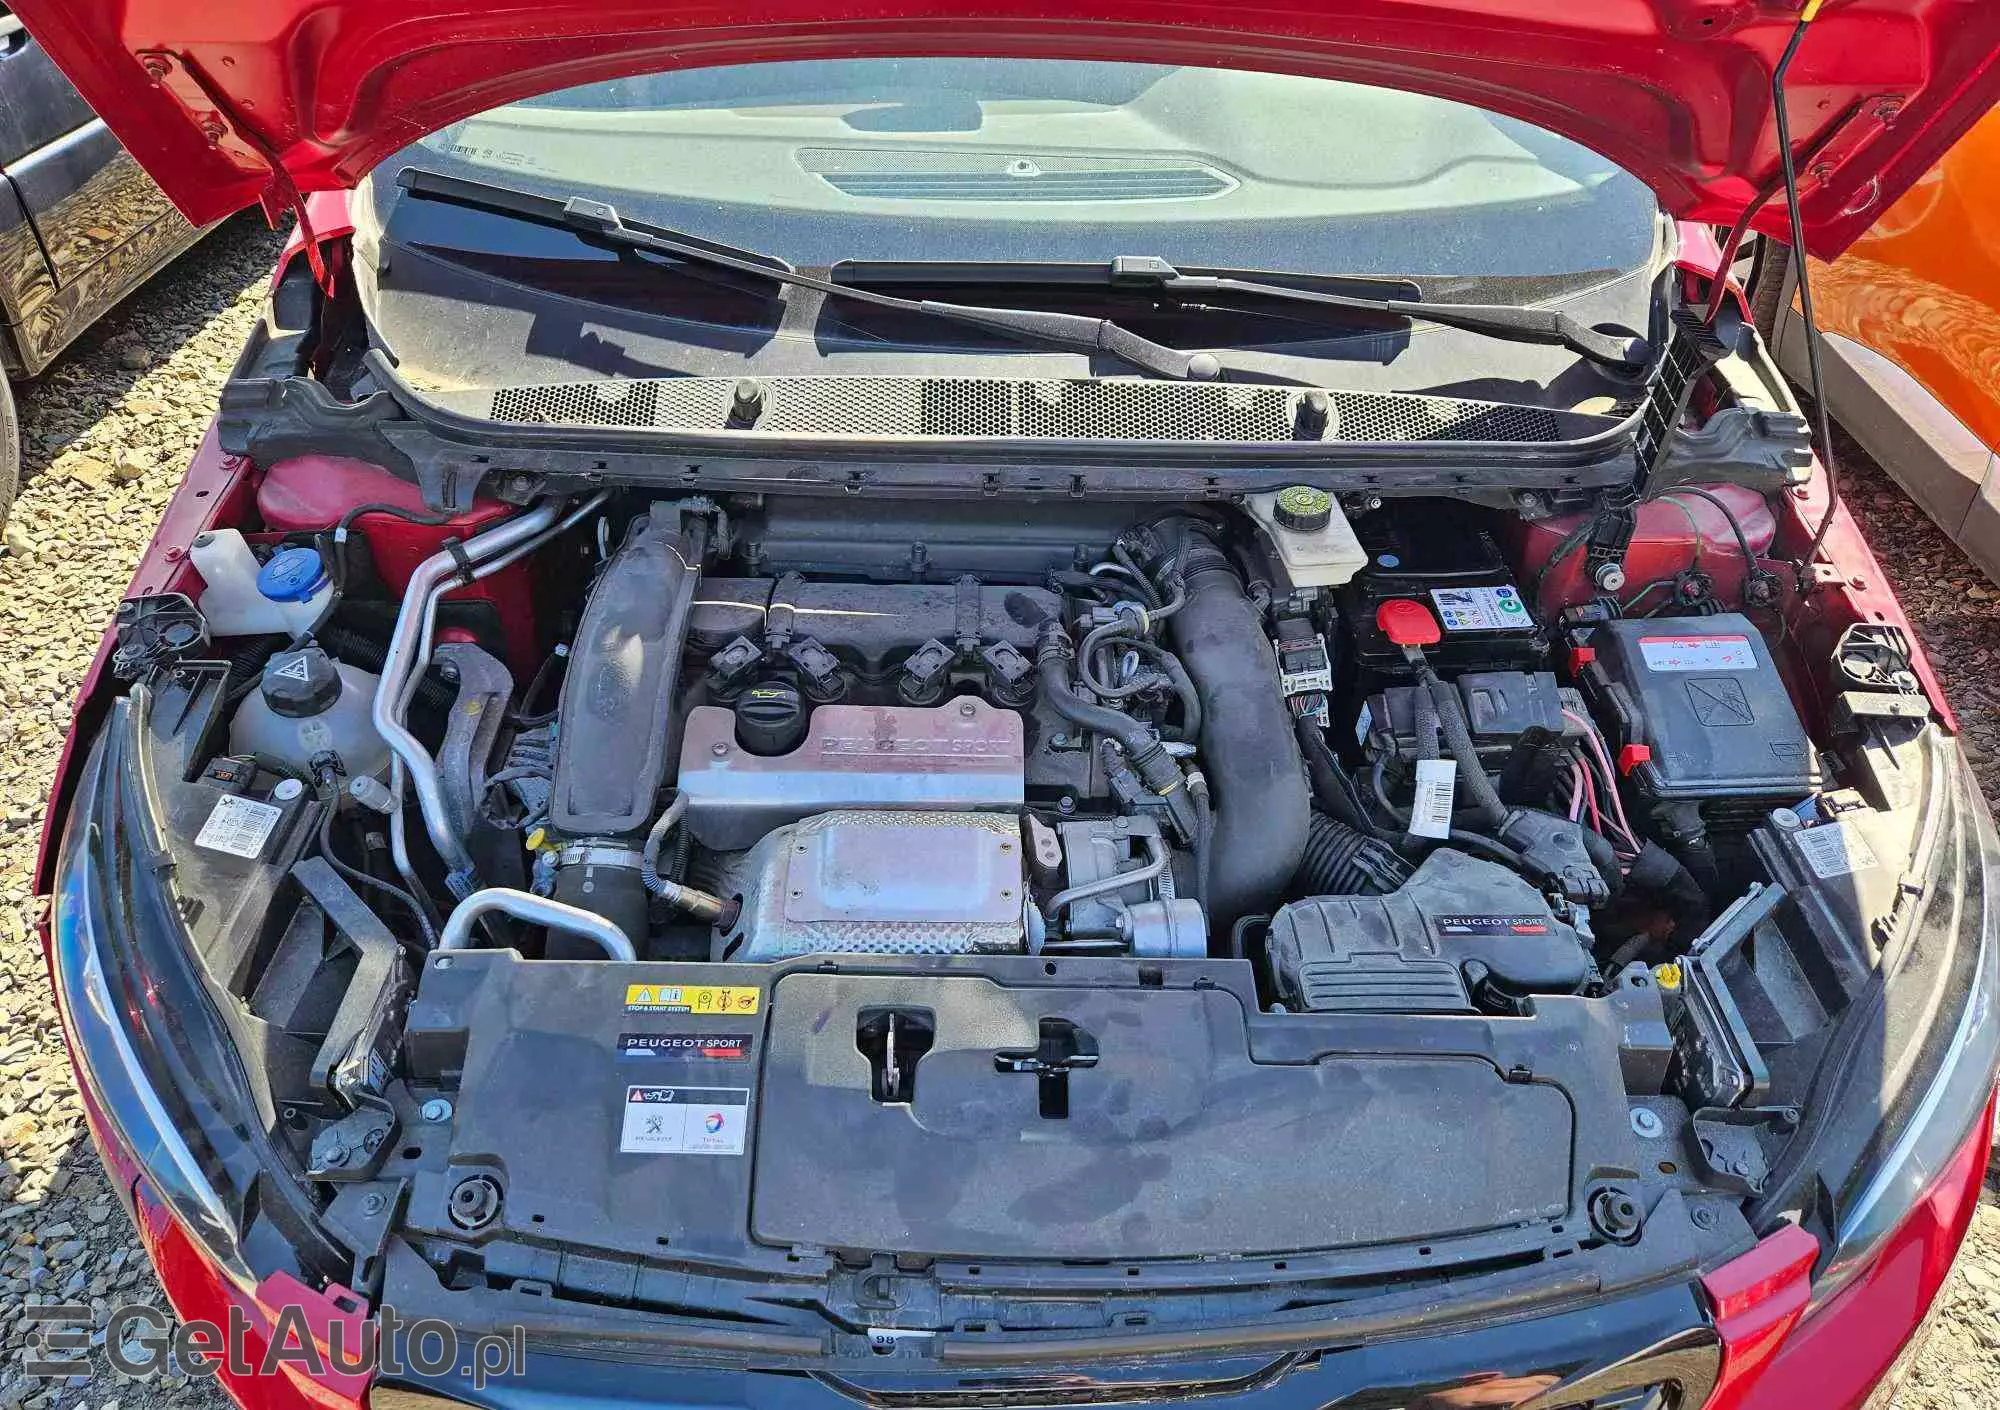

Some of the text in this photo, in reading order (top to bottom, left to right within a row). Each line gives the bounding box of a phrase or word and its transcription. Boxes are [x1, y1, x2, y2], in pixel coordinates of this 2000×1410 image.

[1443, 918, 1509, 926] PEUGEOT
[627, 1038, 742, 1048] PEUGEOT SPORT
[876, 1335, 895, 1344] 98
